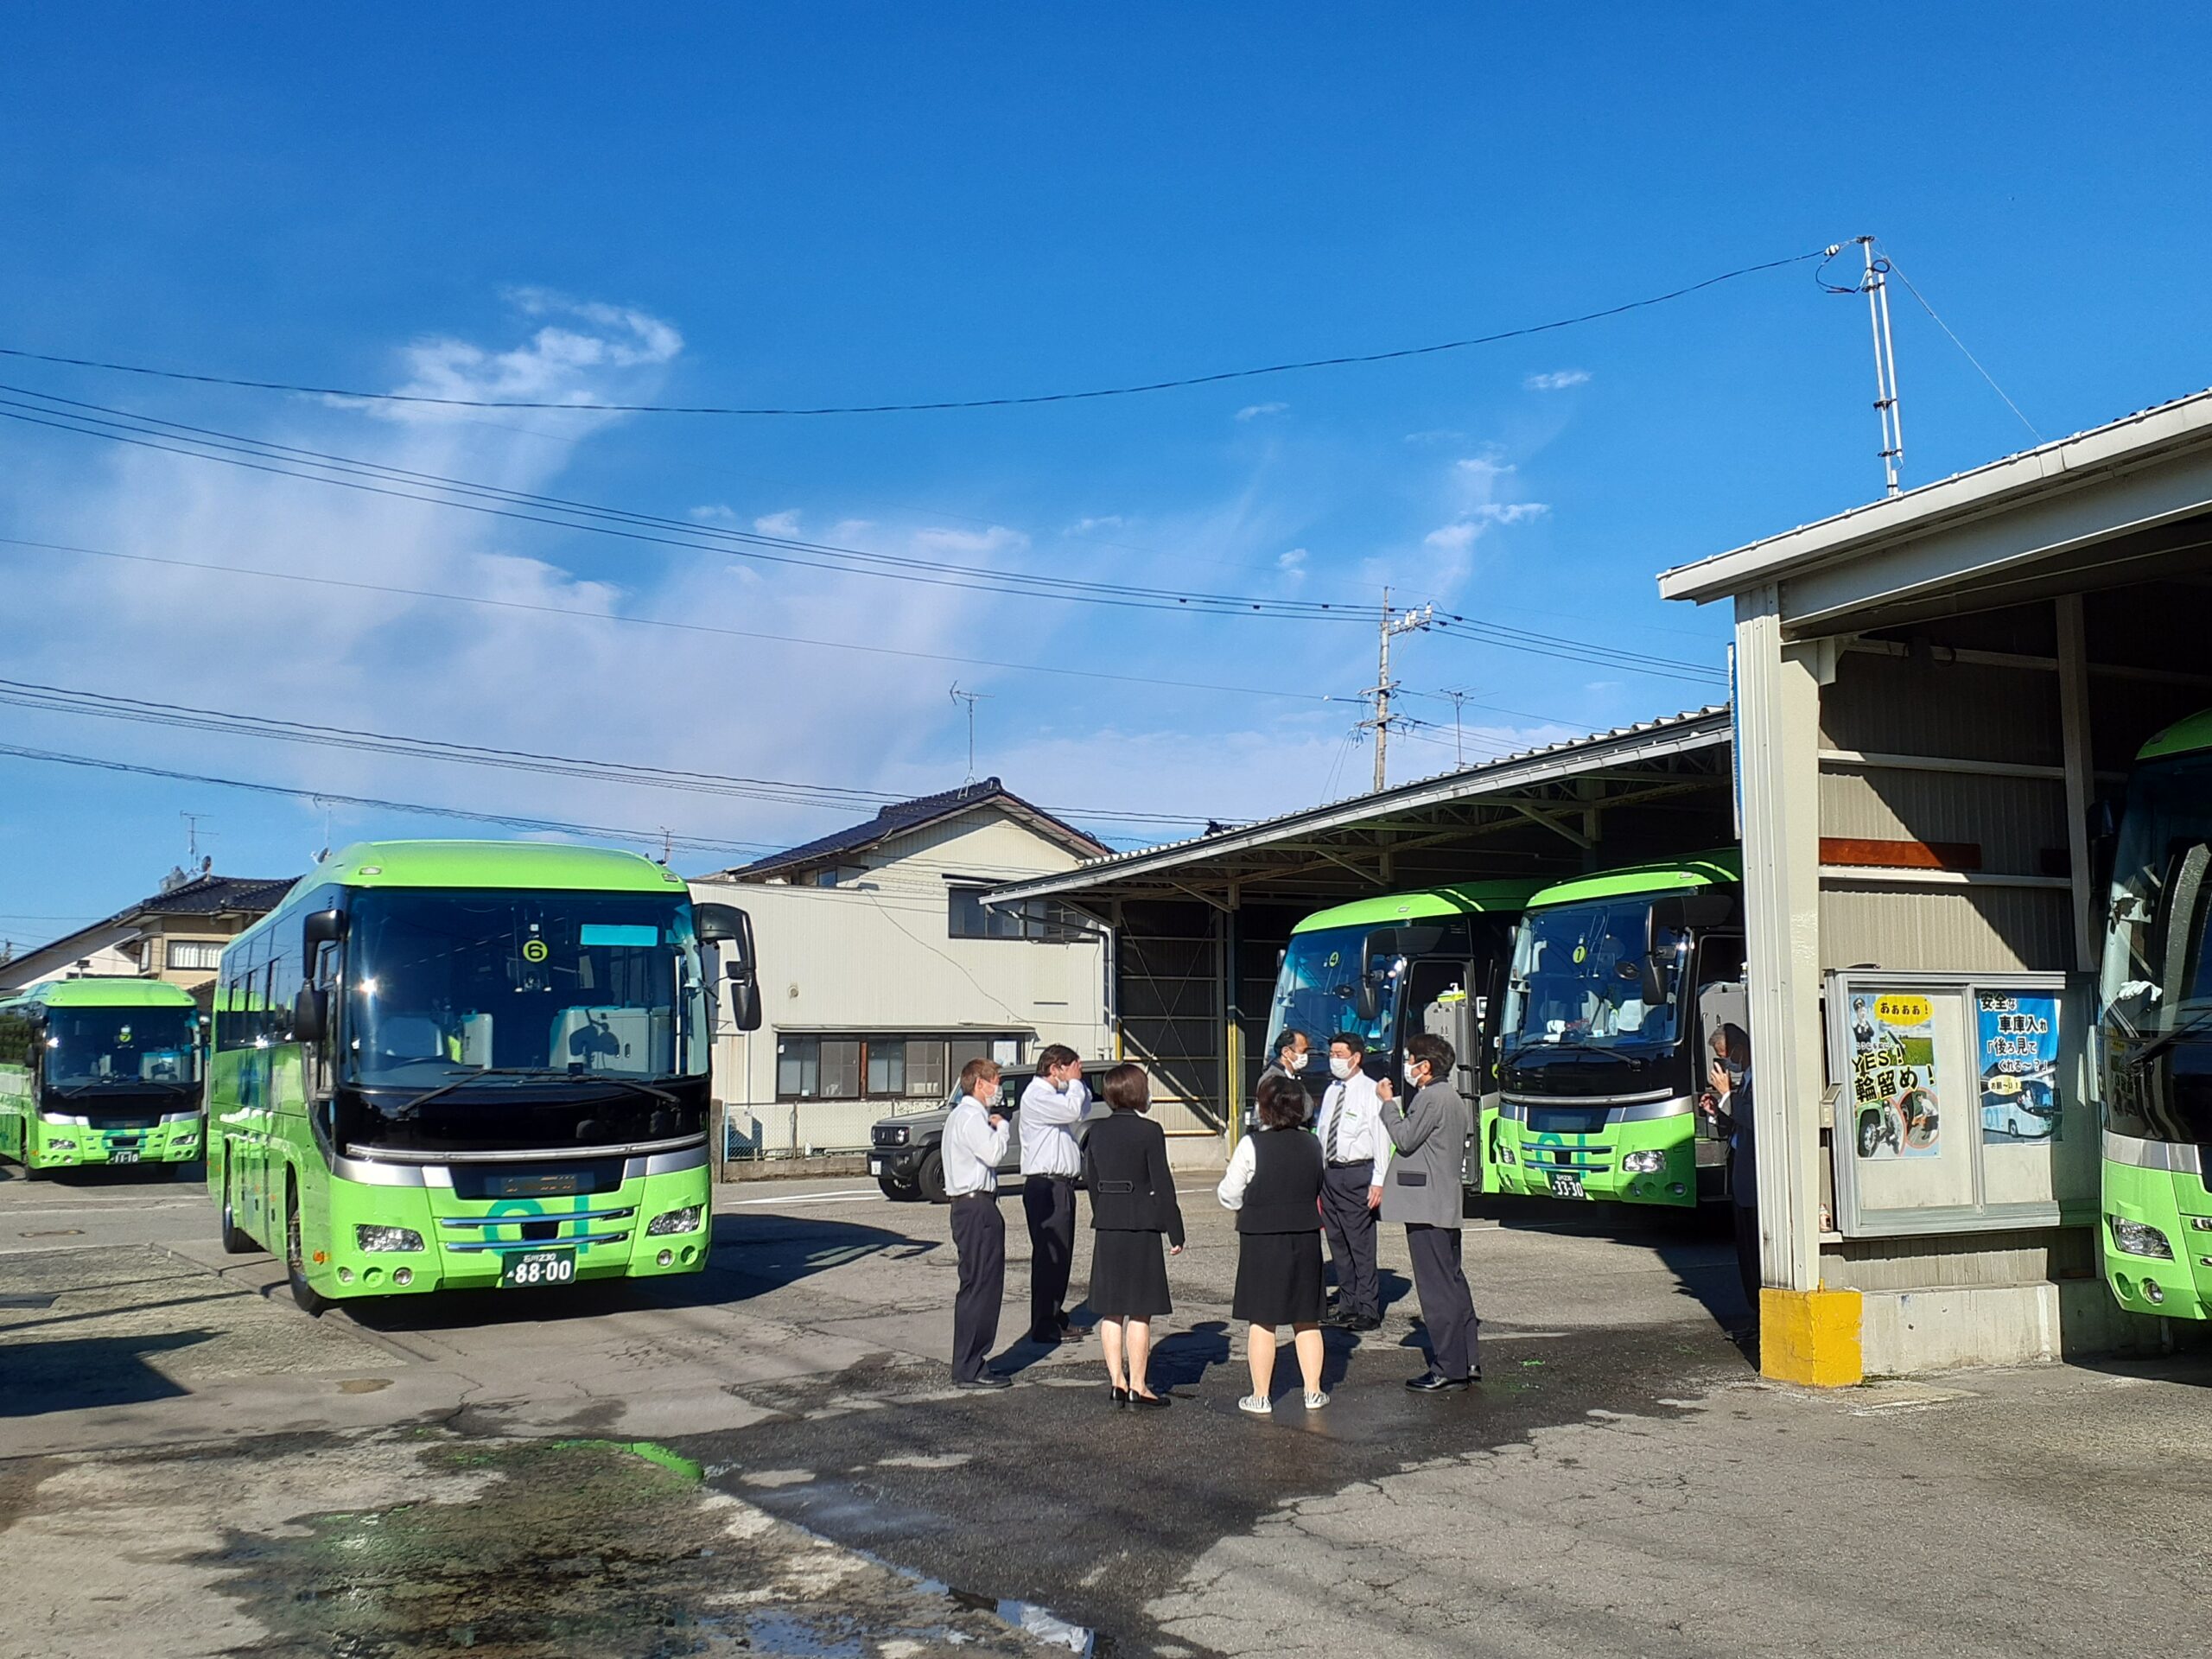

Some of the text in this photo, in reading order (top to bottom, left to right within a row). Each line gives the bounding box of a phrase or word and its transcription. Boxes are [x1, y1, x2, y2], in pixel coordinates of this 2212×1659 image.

[527, 944, 543, 959] 6
[1980, 992, 2016, 1011] 安全な
[1999, 1014, 2047, 1033] 車庫入れ
